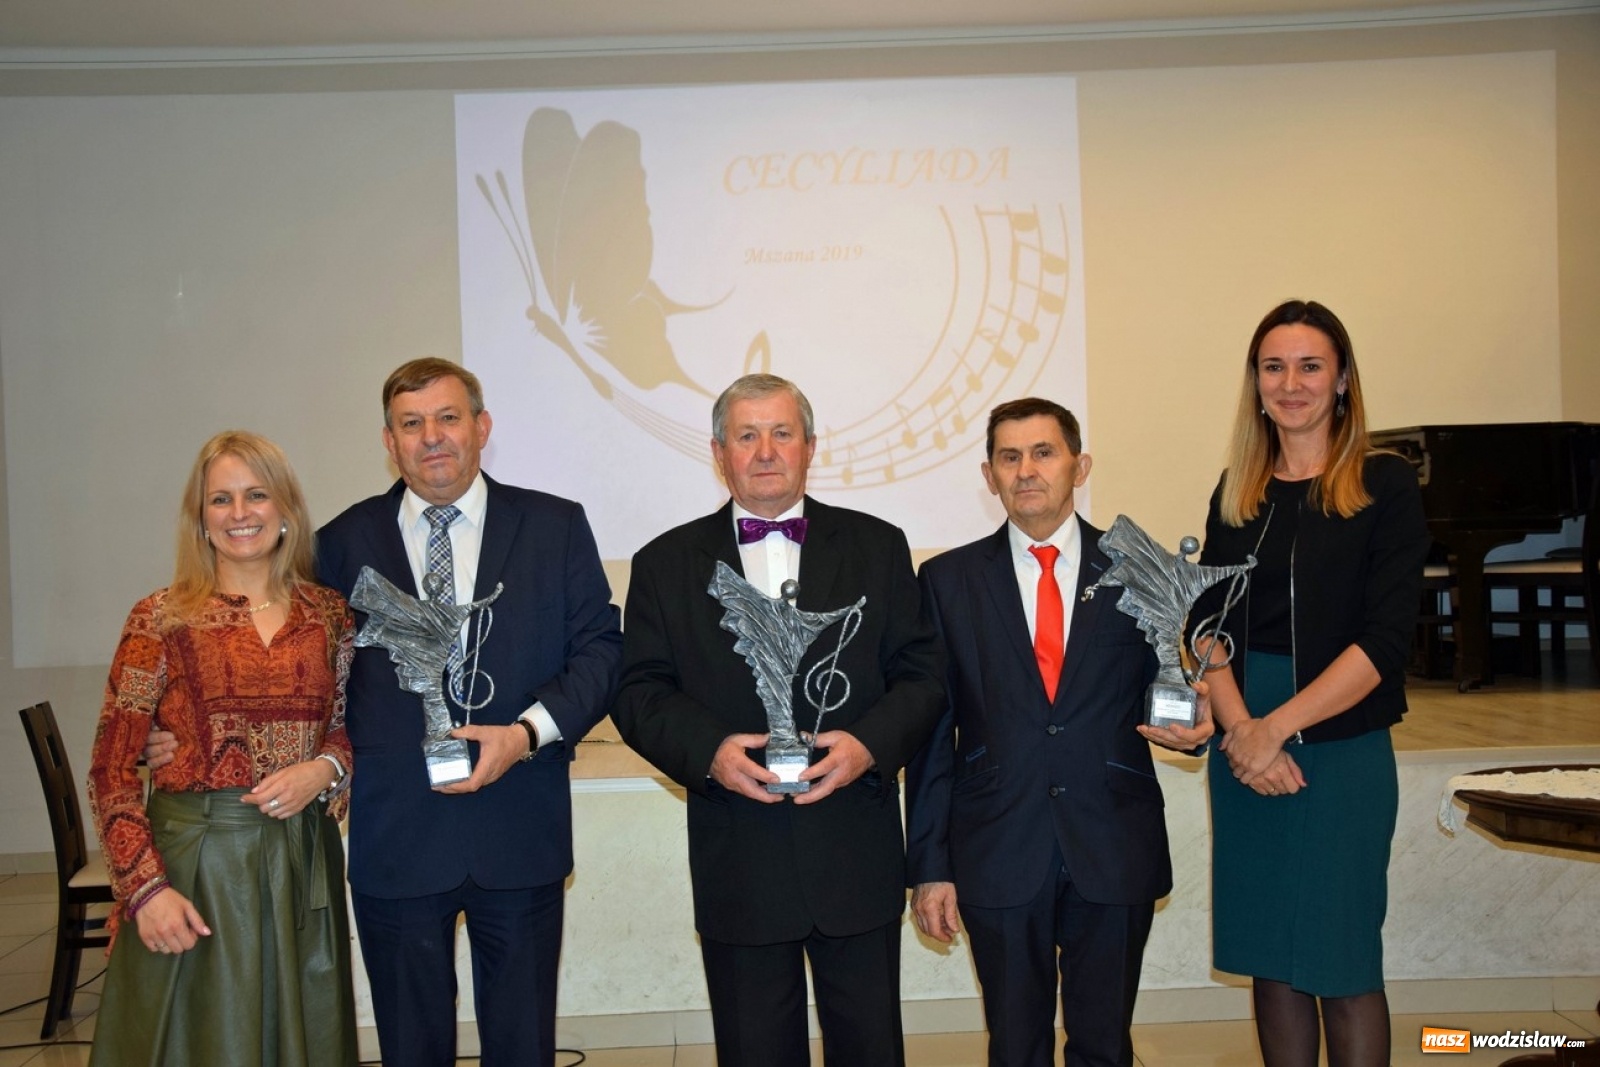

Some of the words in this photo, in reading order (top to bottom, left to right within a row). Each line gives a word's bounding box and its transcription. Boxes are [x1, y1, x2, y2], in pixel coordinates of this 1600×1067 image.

[723, 146, 1010, 195] CECYLIADA
[744, 248, 815, 264] Mszana
[821, 245, 863, 261] 2019
